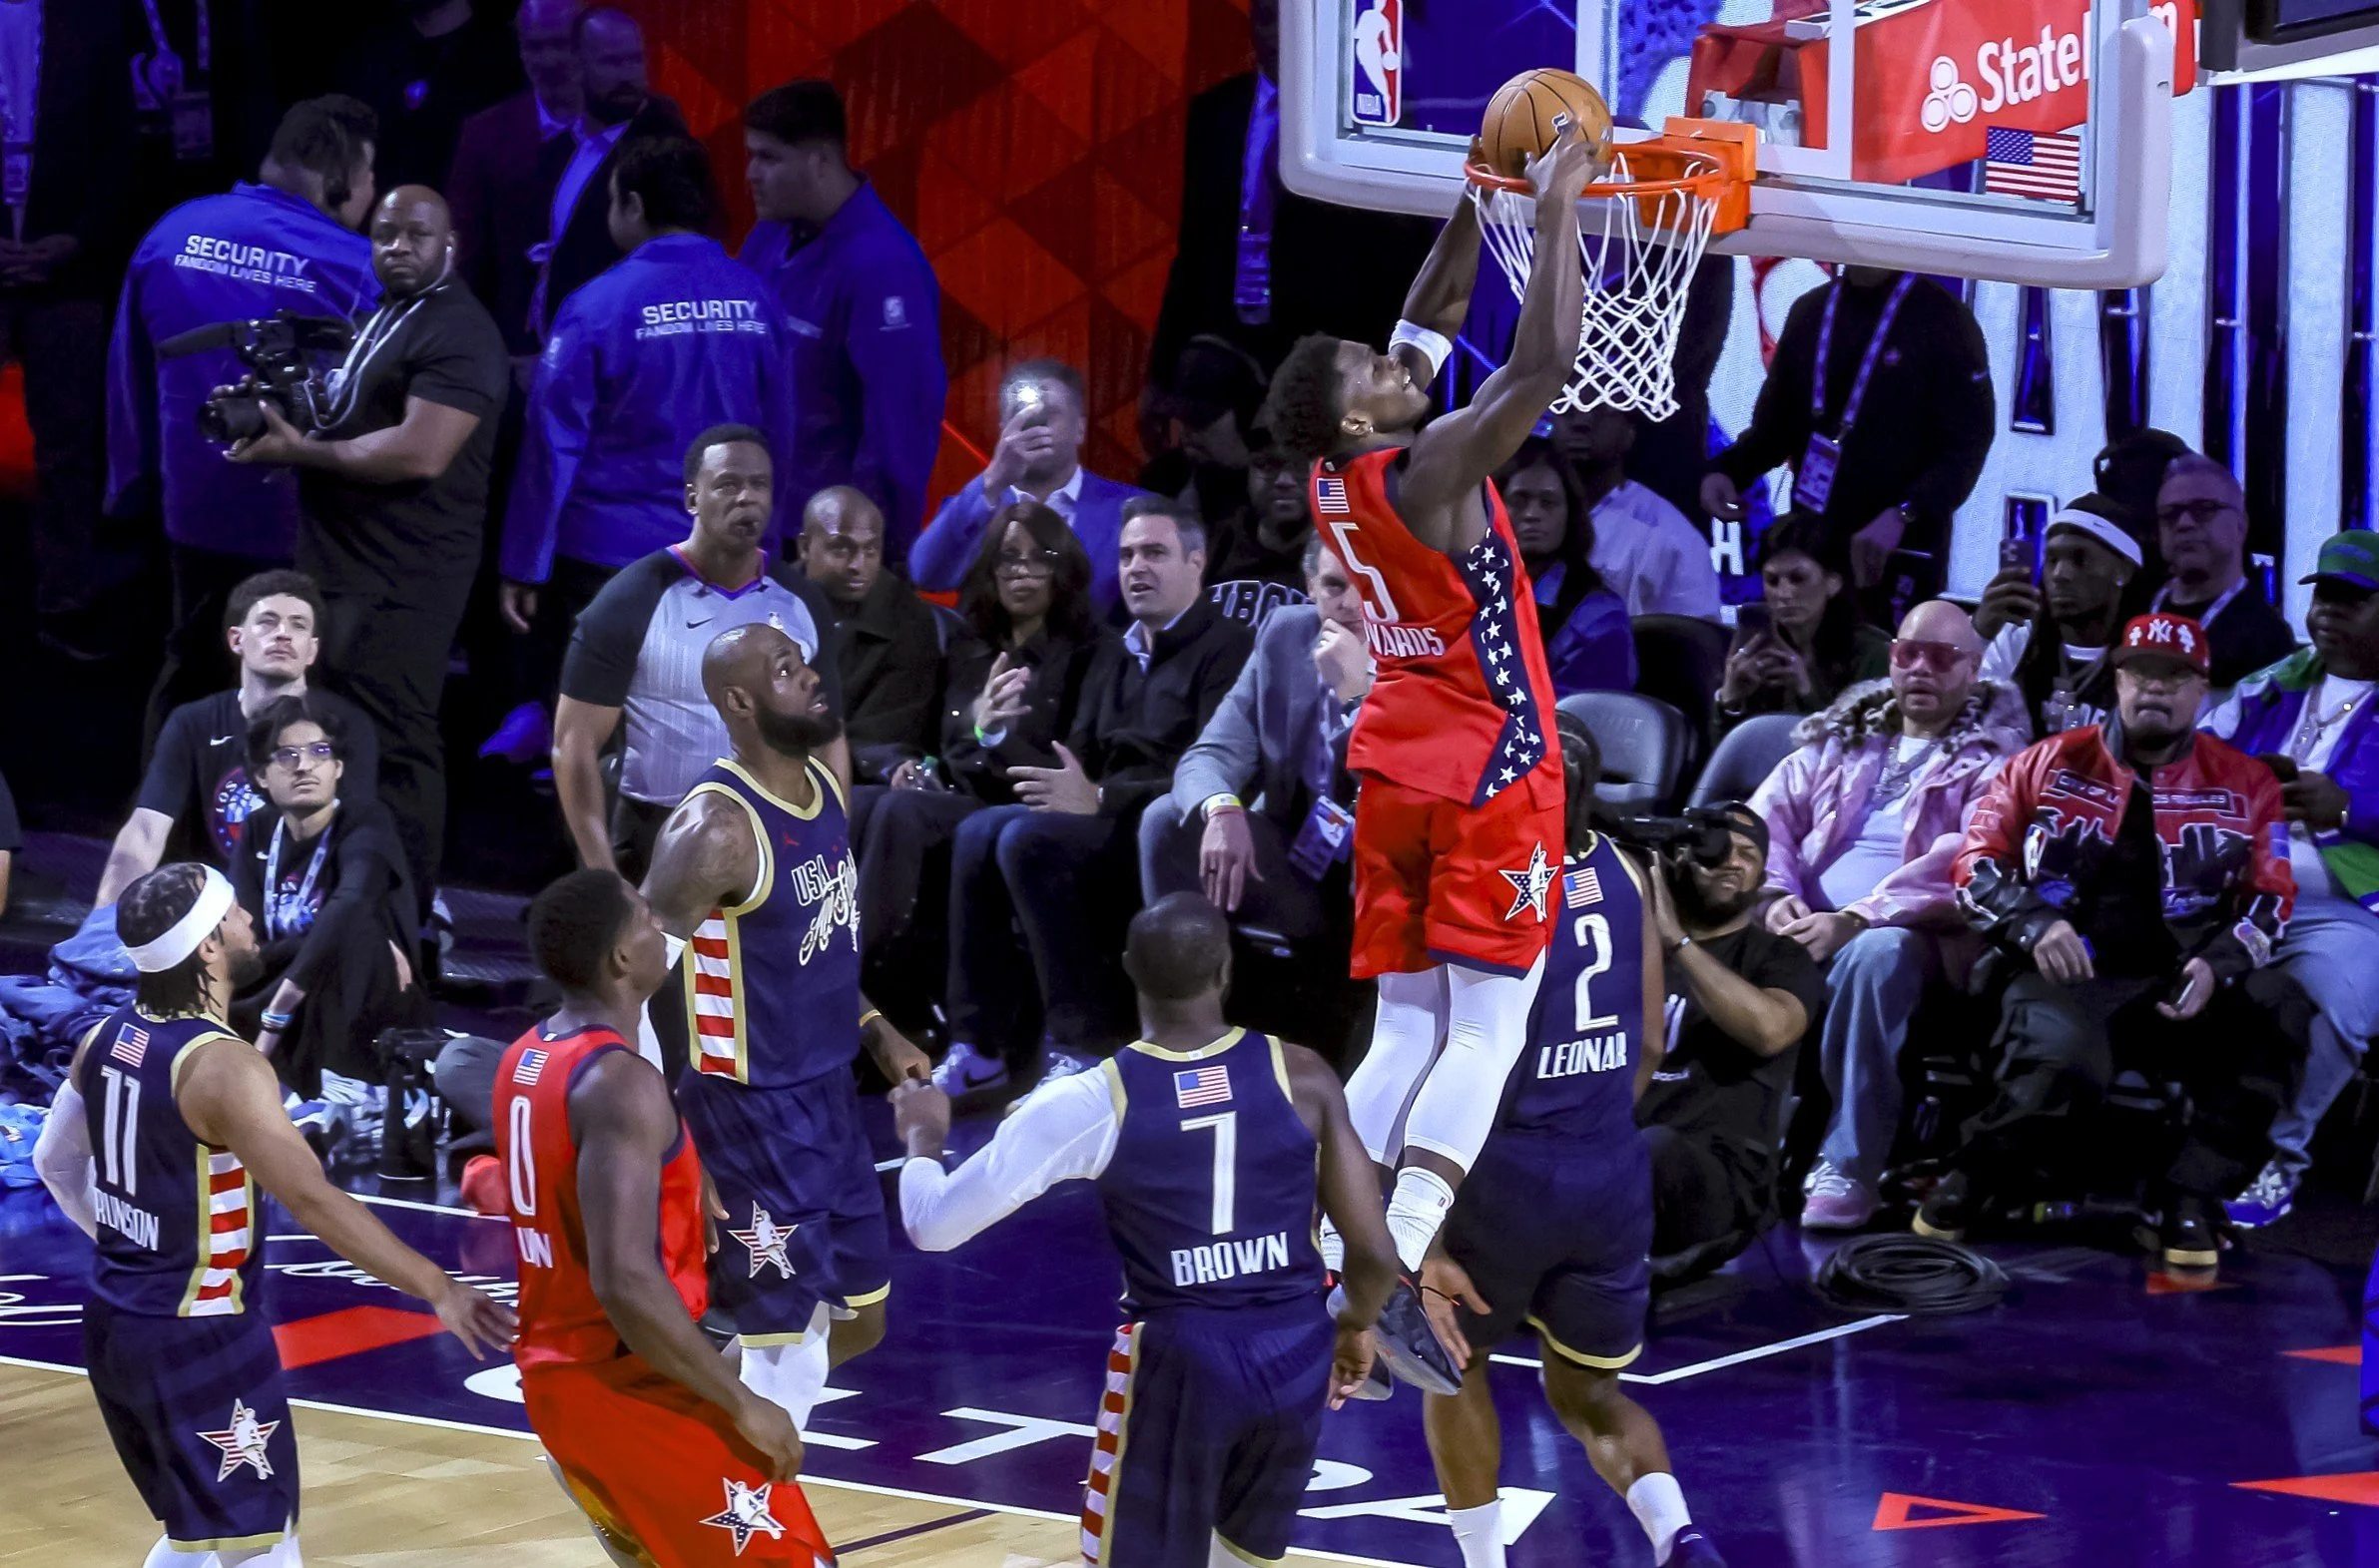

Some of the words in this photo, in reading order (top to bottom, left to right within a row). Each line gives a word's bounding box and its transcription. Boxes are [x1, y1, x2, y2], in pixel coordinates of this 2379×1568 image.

[1977, 24, 2081, 113] State
[186, 235, 308, 275] SECURITY
[642, 299, 757, 324] SECURITY
[1329, 521, 1399, 624] 5
[791, 853, 832, 906] USA
[1573, 912, 1618, 1032] 2
[101, 1064, 141, 1197] 11
[510, 1094, 536, 1216] 0
[1180, 1110, 1237, 1236] 7
[1171, 1231, 1290, 1288] BROWN
